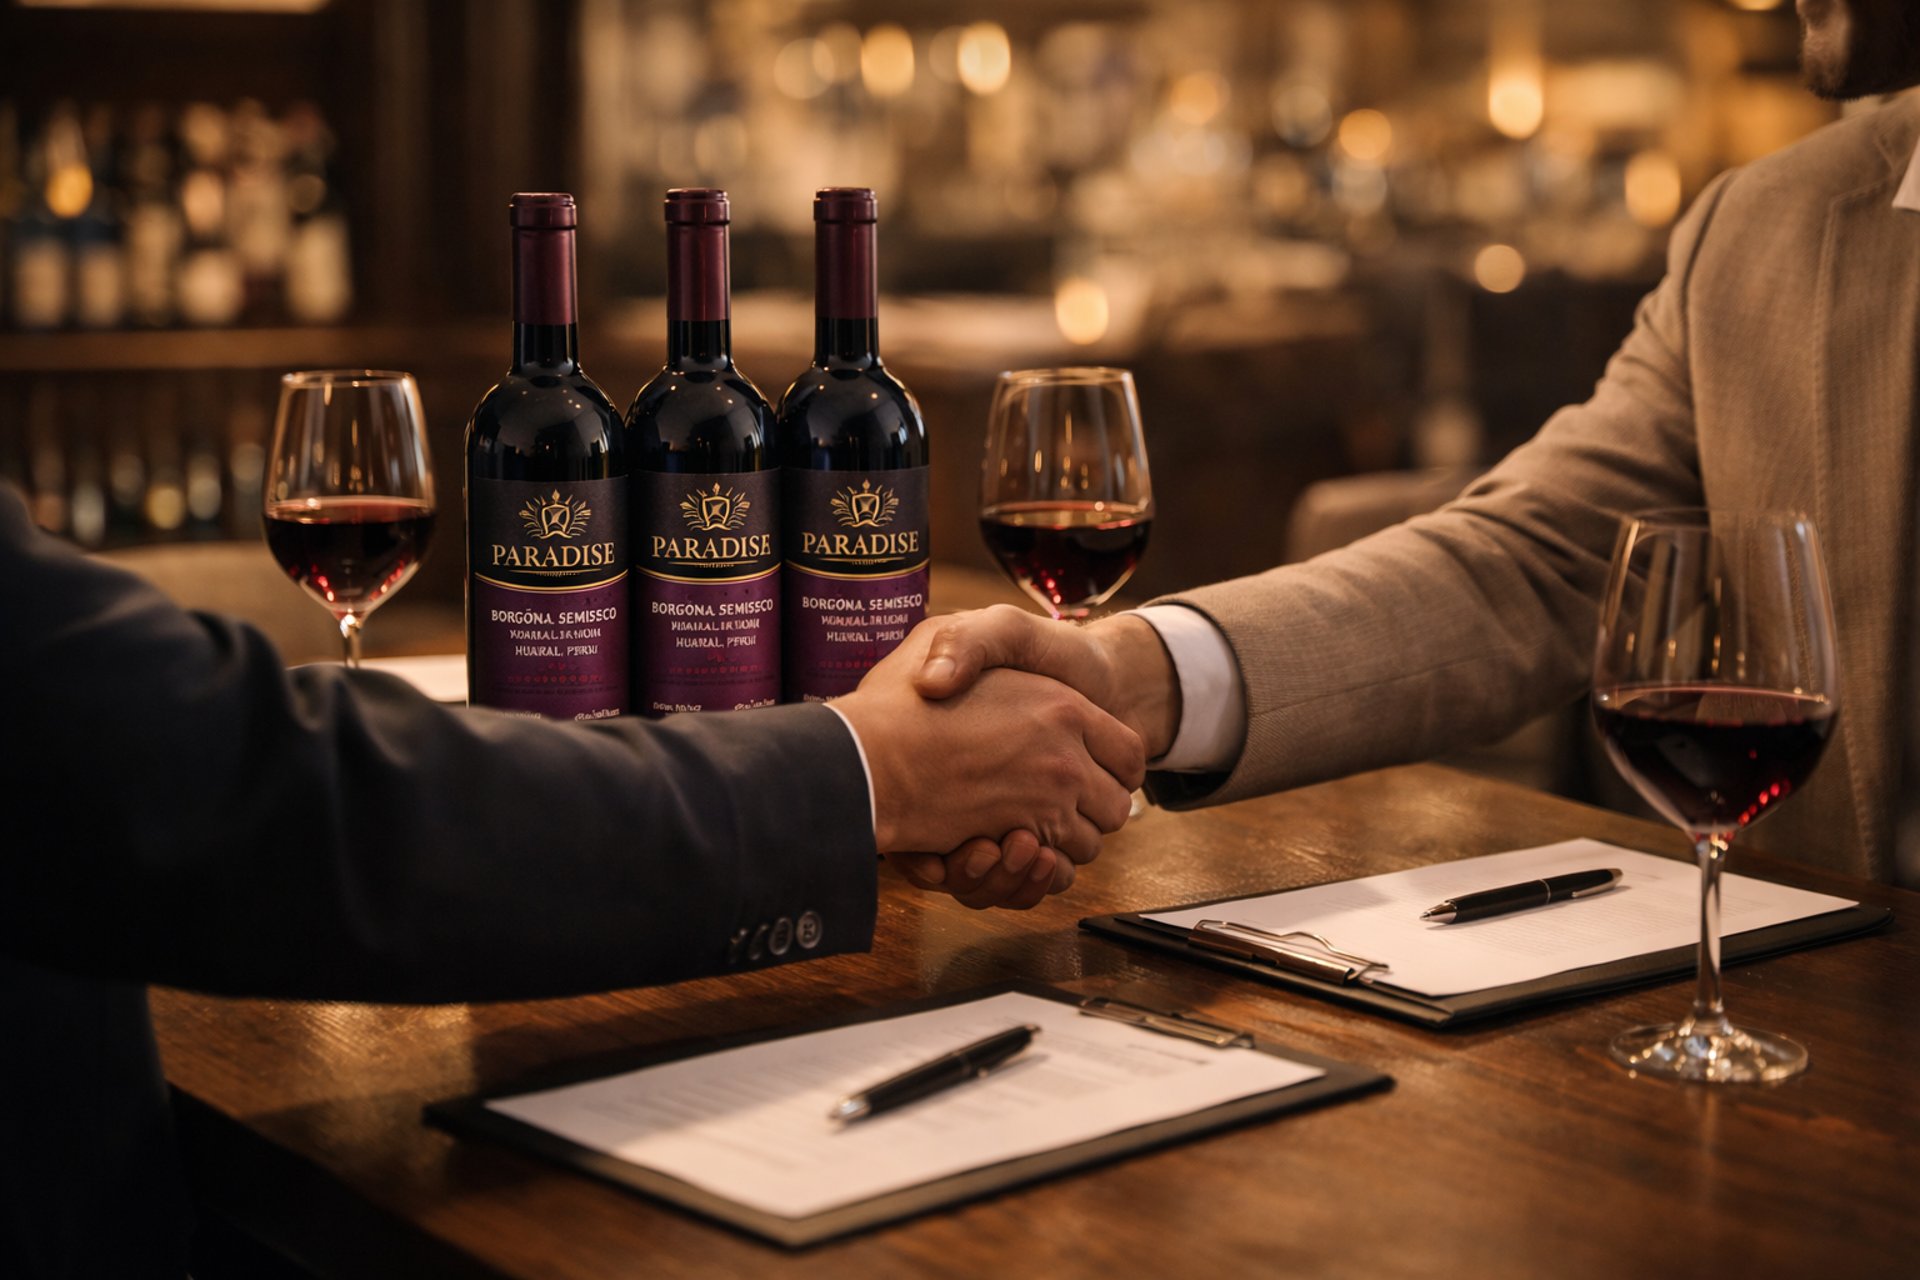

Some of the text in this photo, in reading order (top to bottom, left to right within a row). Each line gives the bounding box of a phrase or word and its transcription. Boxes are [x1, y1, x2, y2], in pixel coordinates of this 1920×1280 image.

[491, 542, 615, 567] PARADISE
[651, 534, 771, 559] PARADISE
[802, 531, 919, 555] PARADISE
